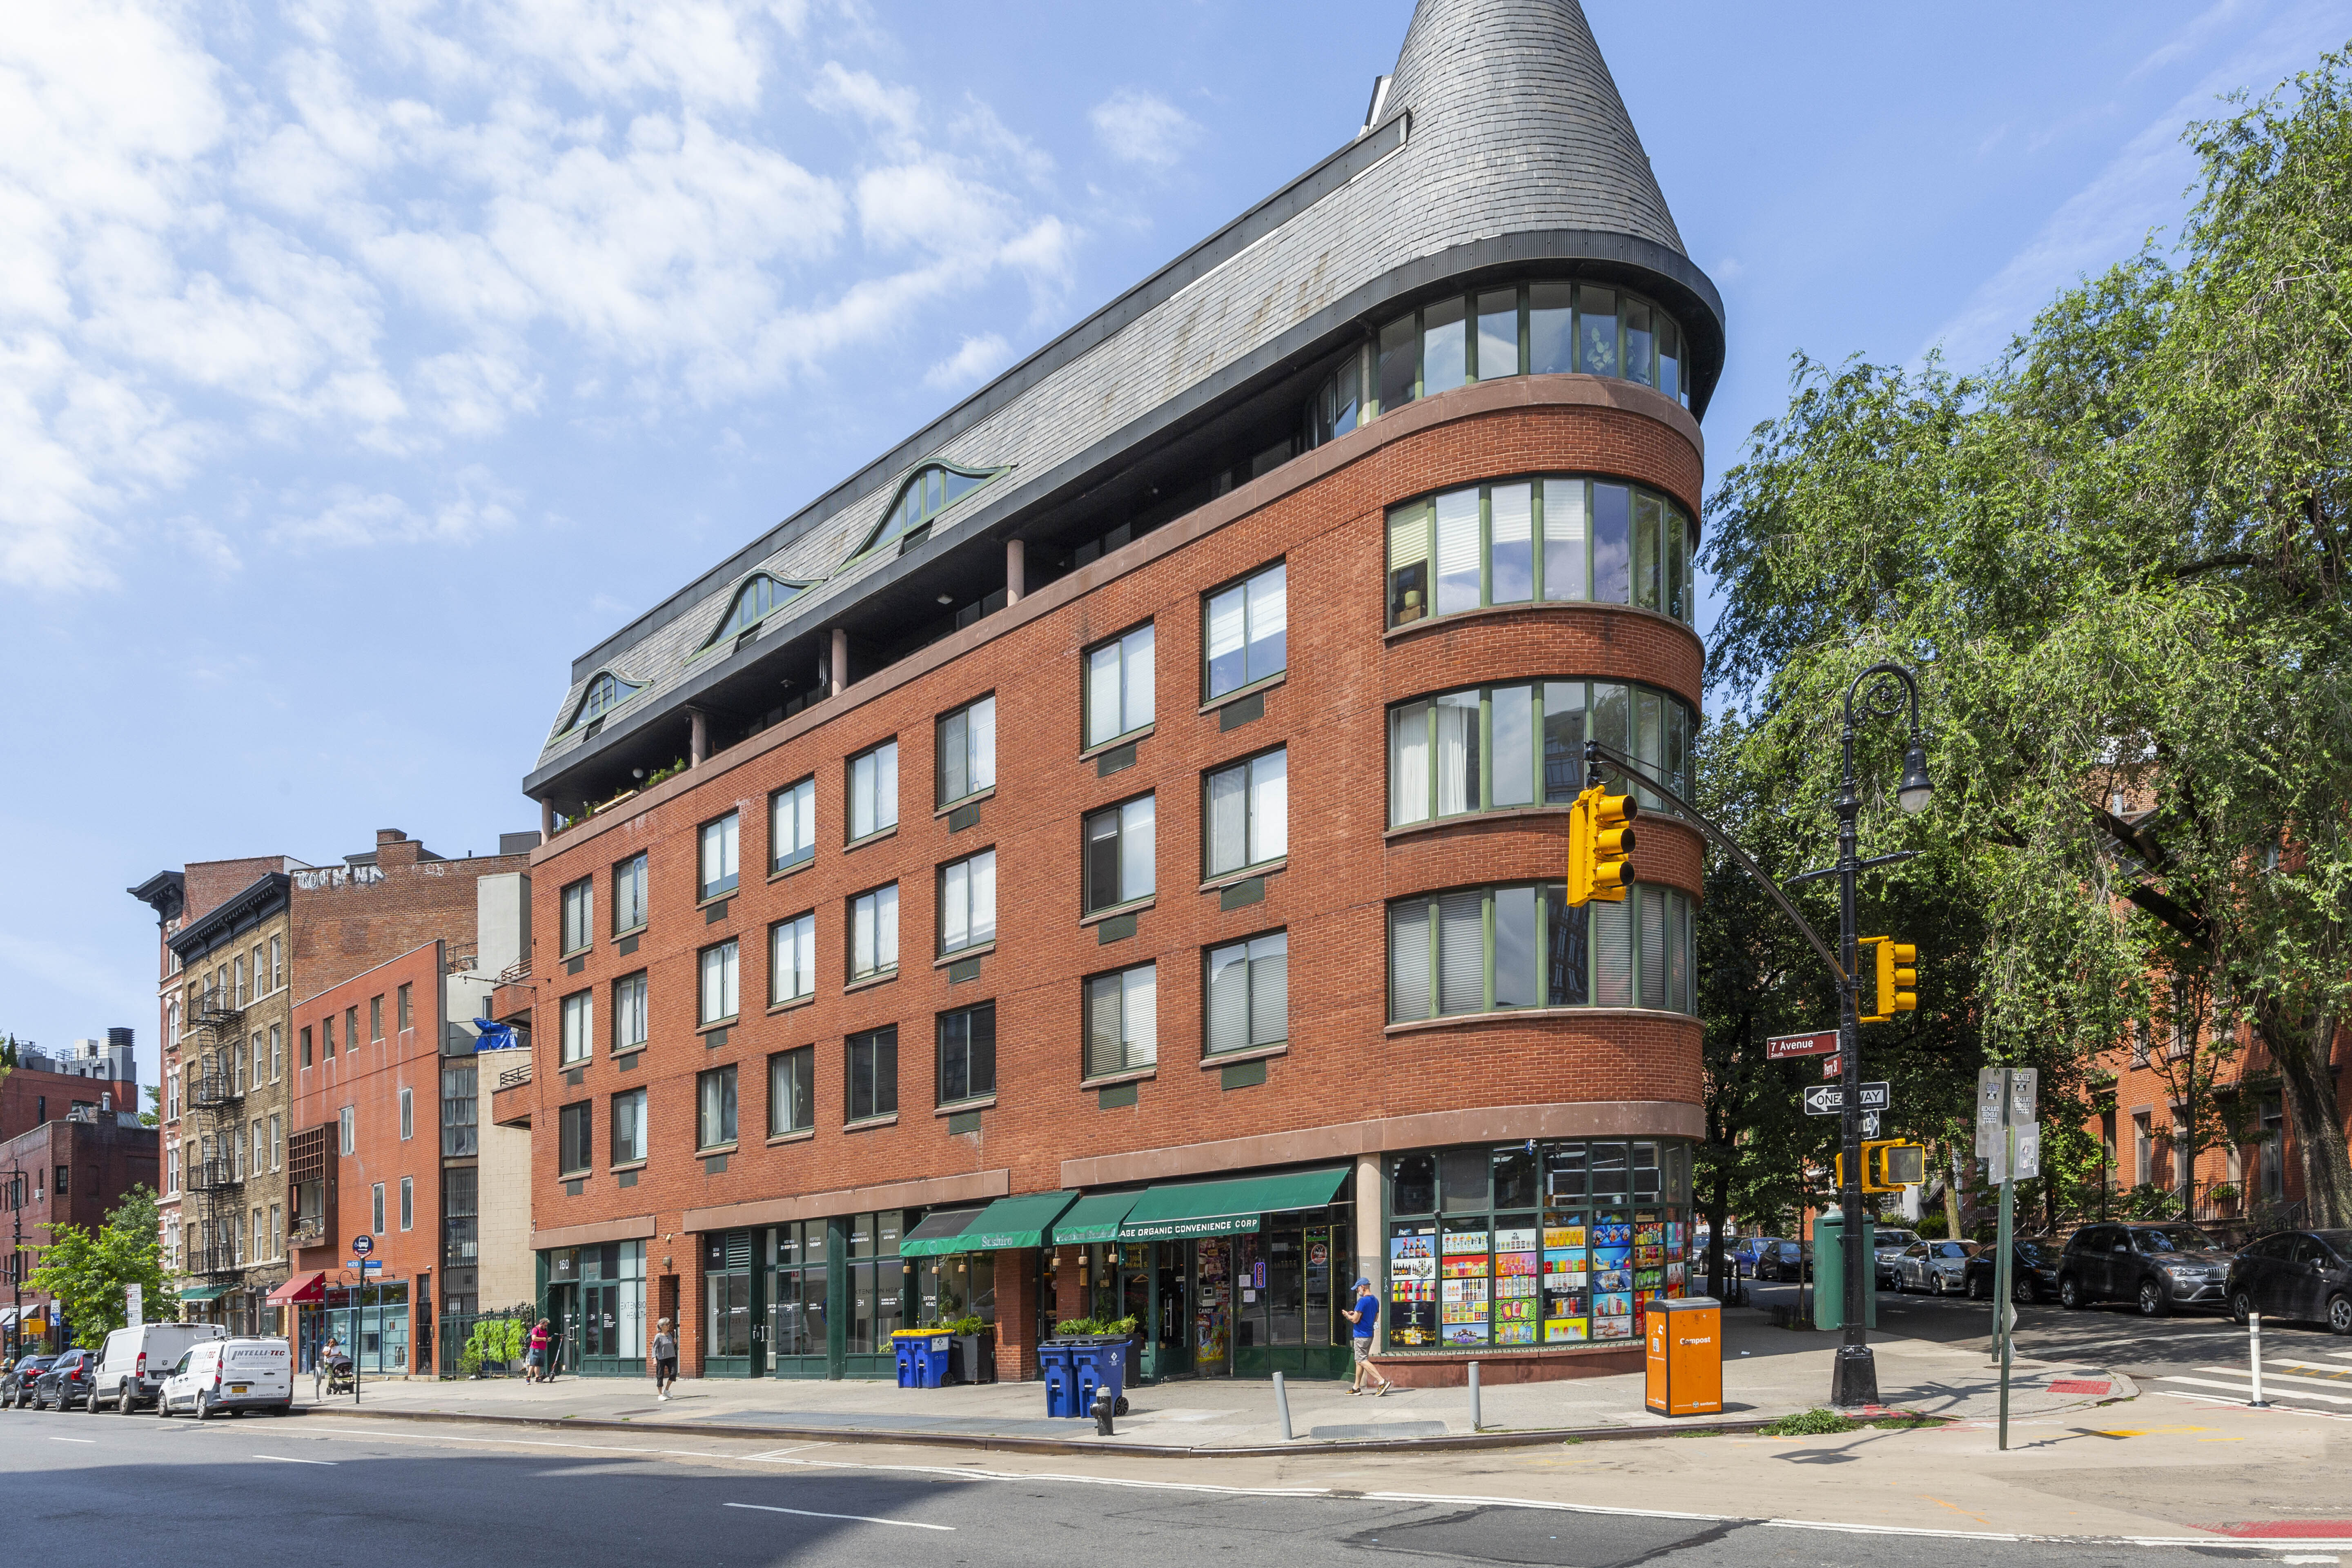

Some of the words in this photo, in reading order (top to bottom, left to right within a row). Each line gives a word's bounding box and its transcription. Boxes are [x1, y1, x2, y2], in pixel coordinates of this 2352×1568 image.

[1771, 1042, 1776, 1052] 7
[1780, 1040, 1813, 1051] Avenue
[1824, 1063, 1833, 1077] Perry
[1833, 1060, 1837, 1073] St
[2013, 1072, 2031, 1081] GENIE
[1986, 1082, 2000, 1091] GENIE
[1817, 1094, 1840, 1105] ONE
[1863, 1118, 1874, 1130] WAY
[1118, 1229, 1136, 1237] AGE
[1138, 1226, 1173, 1236] ORGANIC
[1175, 1221, 1231, 1234] CONVENIENCE
[1235, 1219, 1257, 1228] CORP
[981, 1234, 1013, 1247] Sushiro
[559, 1259, 569, 1270] 160
[621, 1301, 646, 1309] EXTENSIO
[1680, 1336, 1711, 1345] Compost
[231, 1350, 285, 1360] INTELLI-TEC
